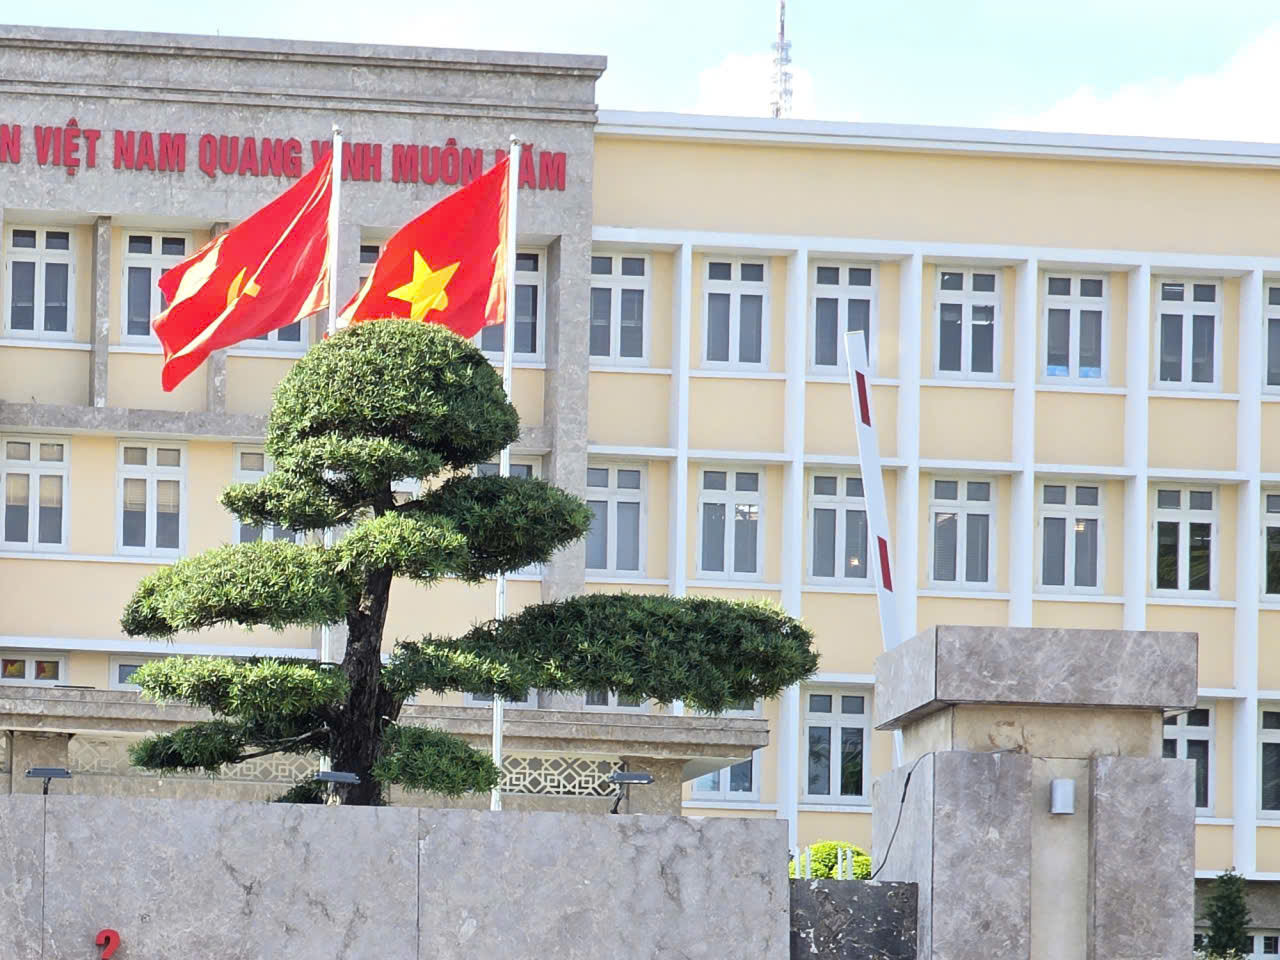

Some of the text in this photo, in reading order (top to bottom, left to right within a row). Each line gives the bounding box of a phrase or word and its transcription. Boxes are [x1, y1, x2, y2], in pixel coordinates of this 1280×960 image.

[34, 117, 101, 176] VIỆT
[113, 130, 187, 172] NAM
[198, 133, 303, 178] QUANG
[310, 140, 383, 182] VNH
[391, 137, 484, 186] MUÔN
[495, 144, 567, 191] ĂM
